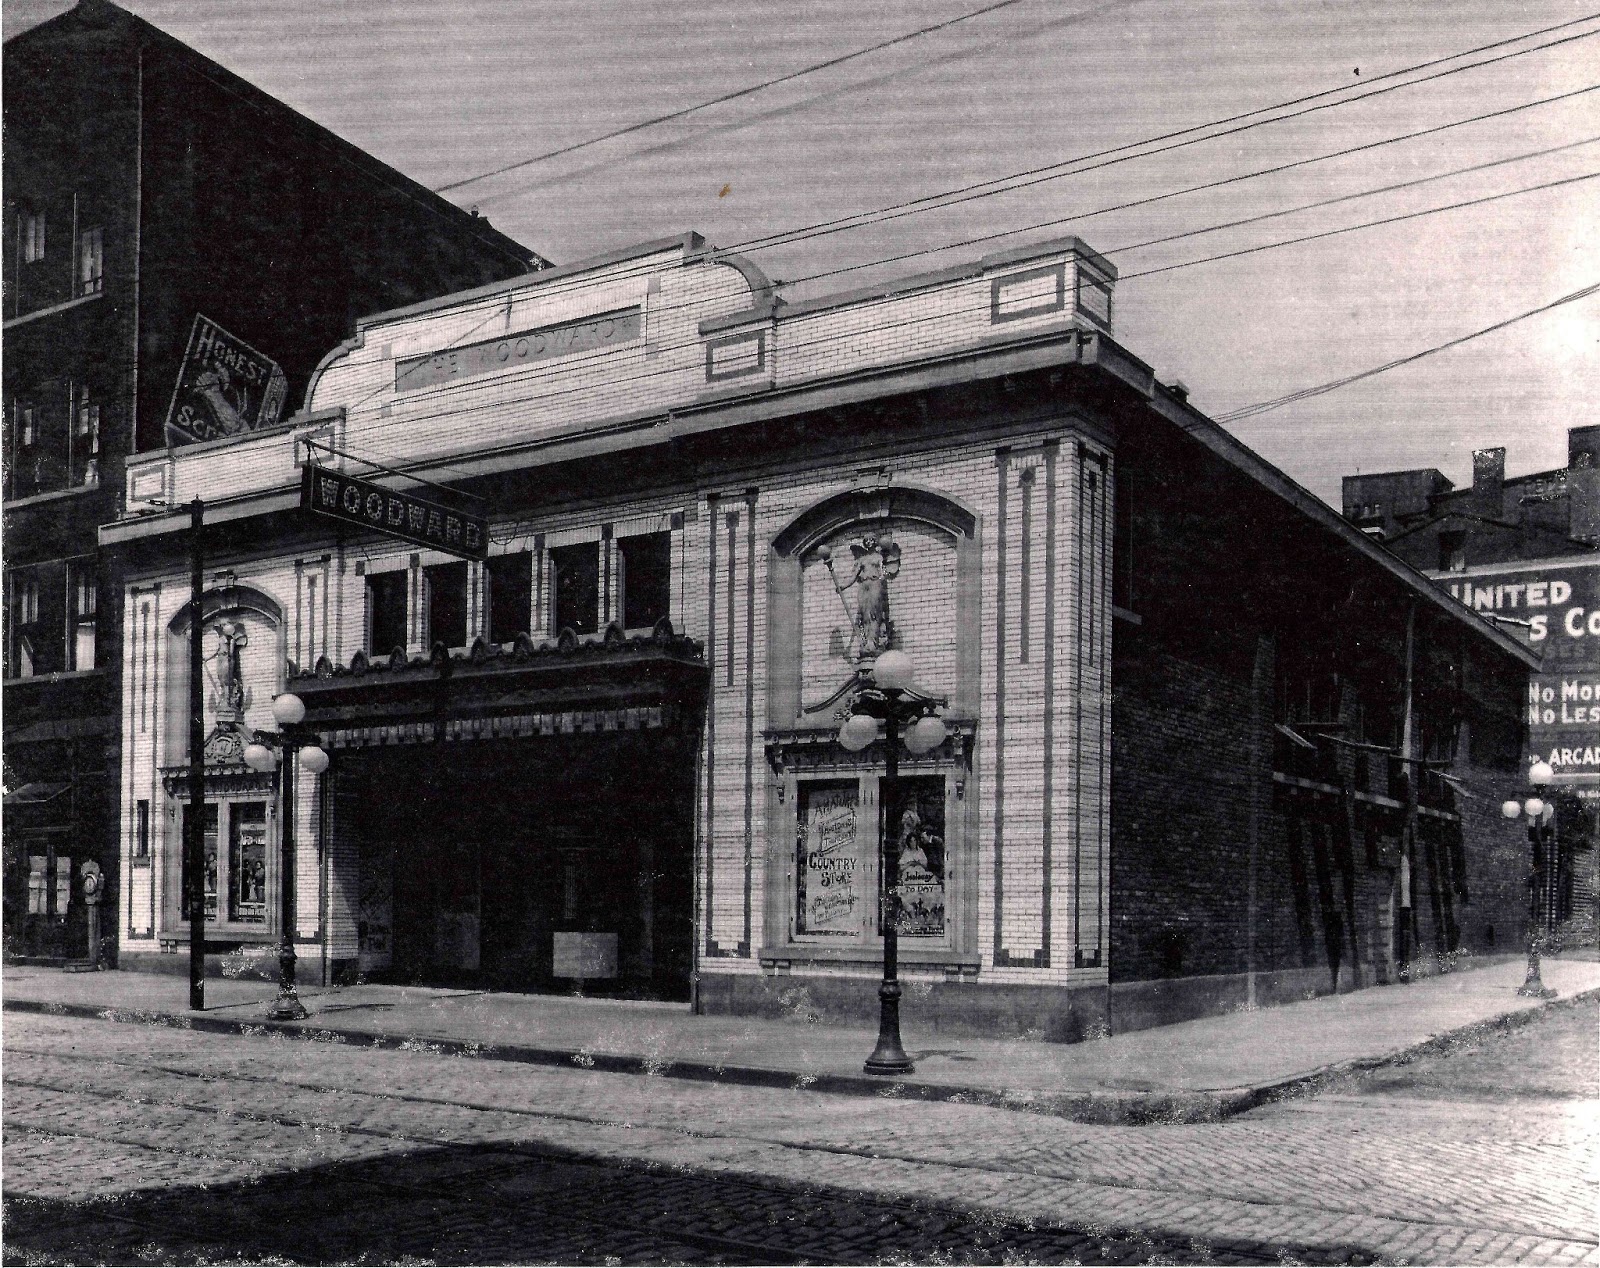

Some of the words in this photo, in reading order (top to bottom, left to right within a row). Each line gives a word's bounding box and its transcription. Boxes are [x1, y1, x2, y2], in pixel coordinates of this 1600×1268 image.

[193, 323, 268, 385] HONEST
[320, 476, 480, 549] WOODWARD
[1451, 580, 1572, 611] UNITED
[808, 851, 857, 870] COUNTRY
[820, 871, 852, 887] STORE
